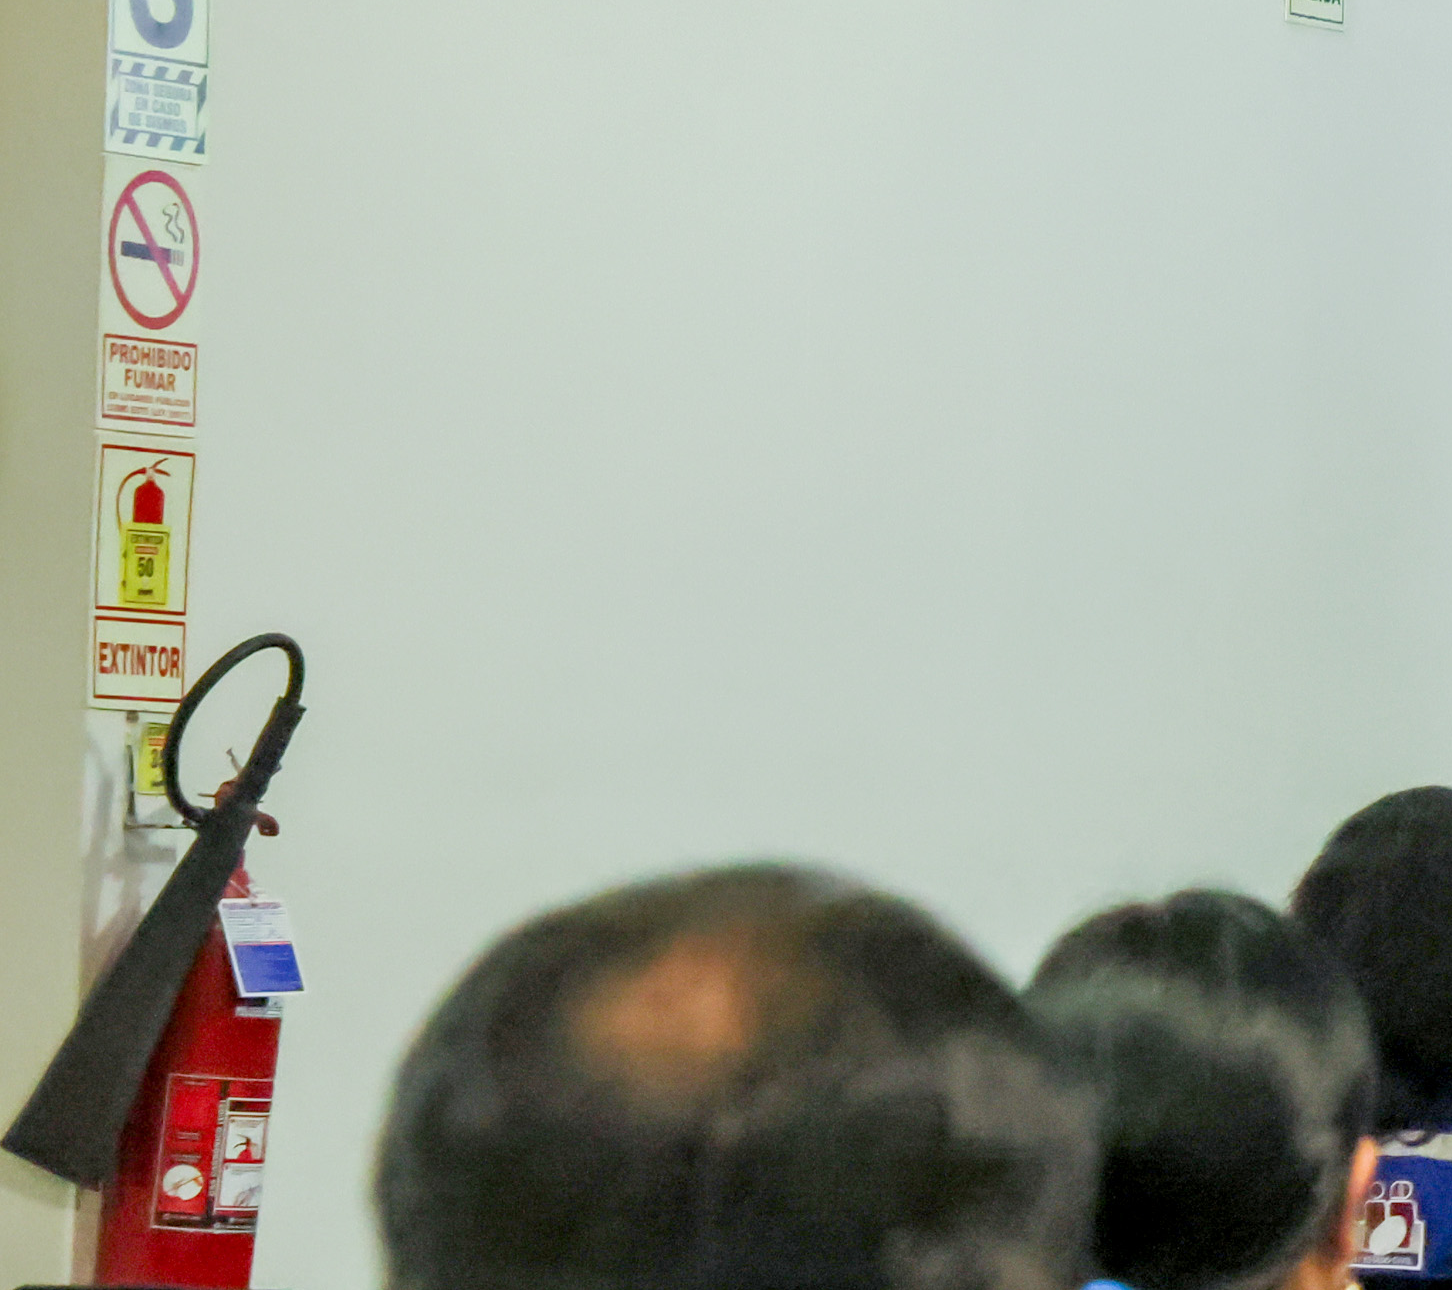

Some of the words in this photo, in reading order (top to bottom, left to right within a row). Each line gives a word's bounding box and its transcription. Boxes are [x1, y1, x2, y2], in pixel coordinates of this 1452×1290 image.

[110, 342, 192, 371] PROHIBIDO
[124, 368, 176, 392] FUMAR
[98, 641, 181, 679] EXTINTOR
